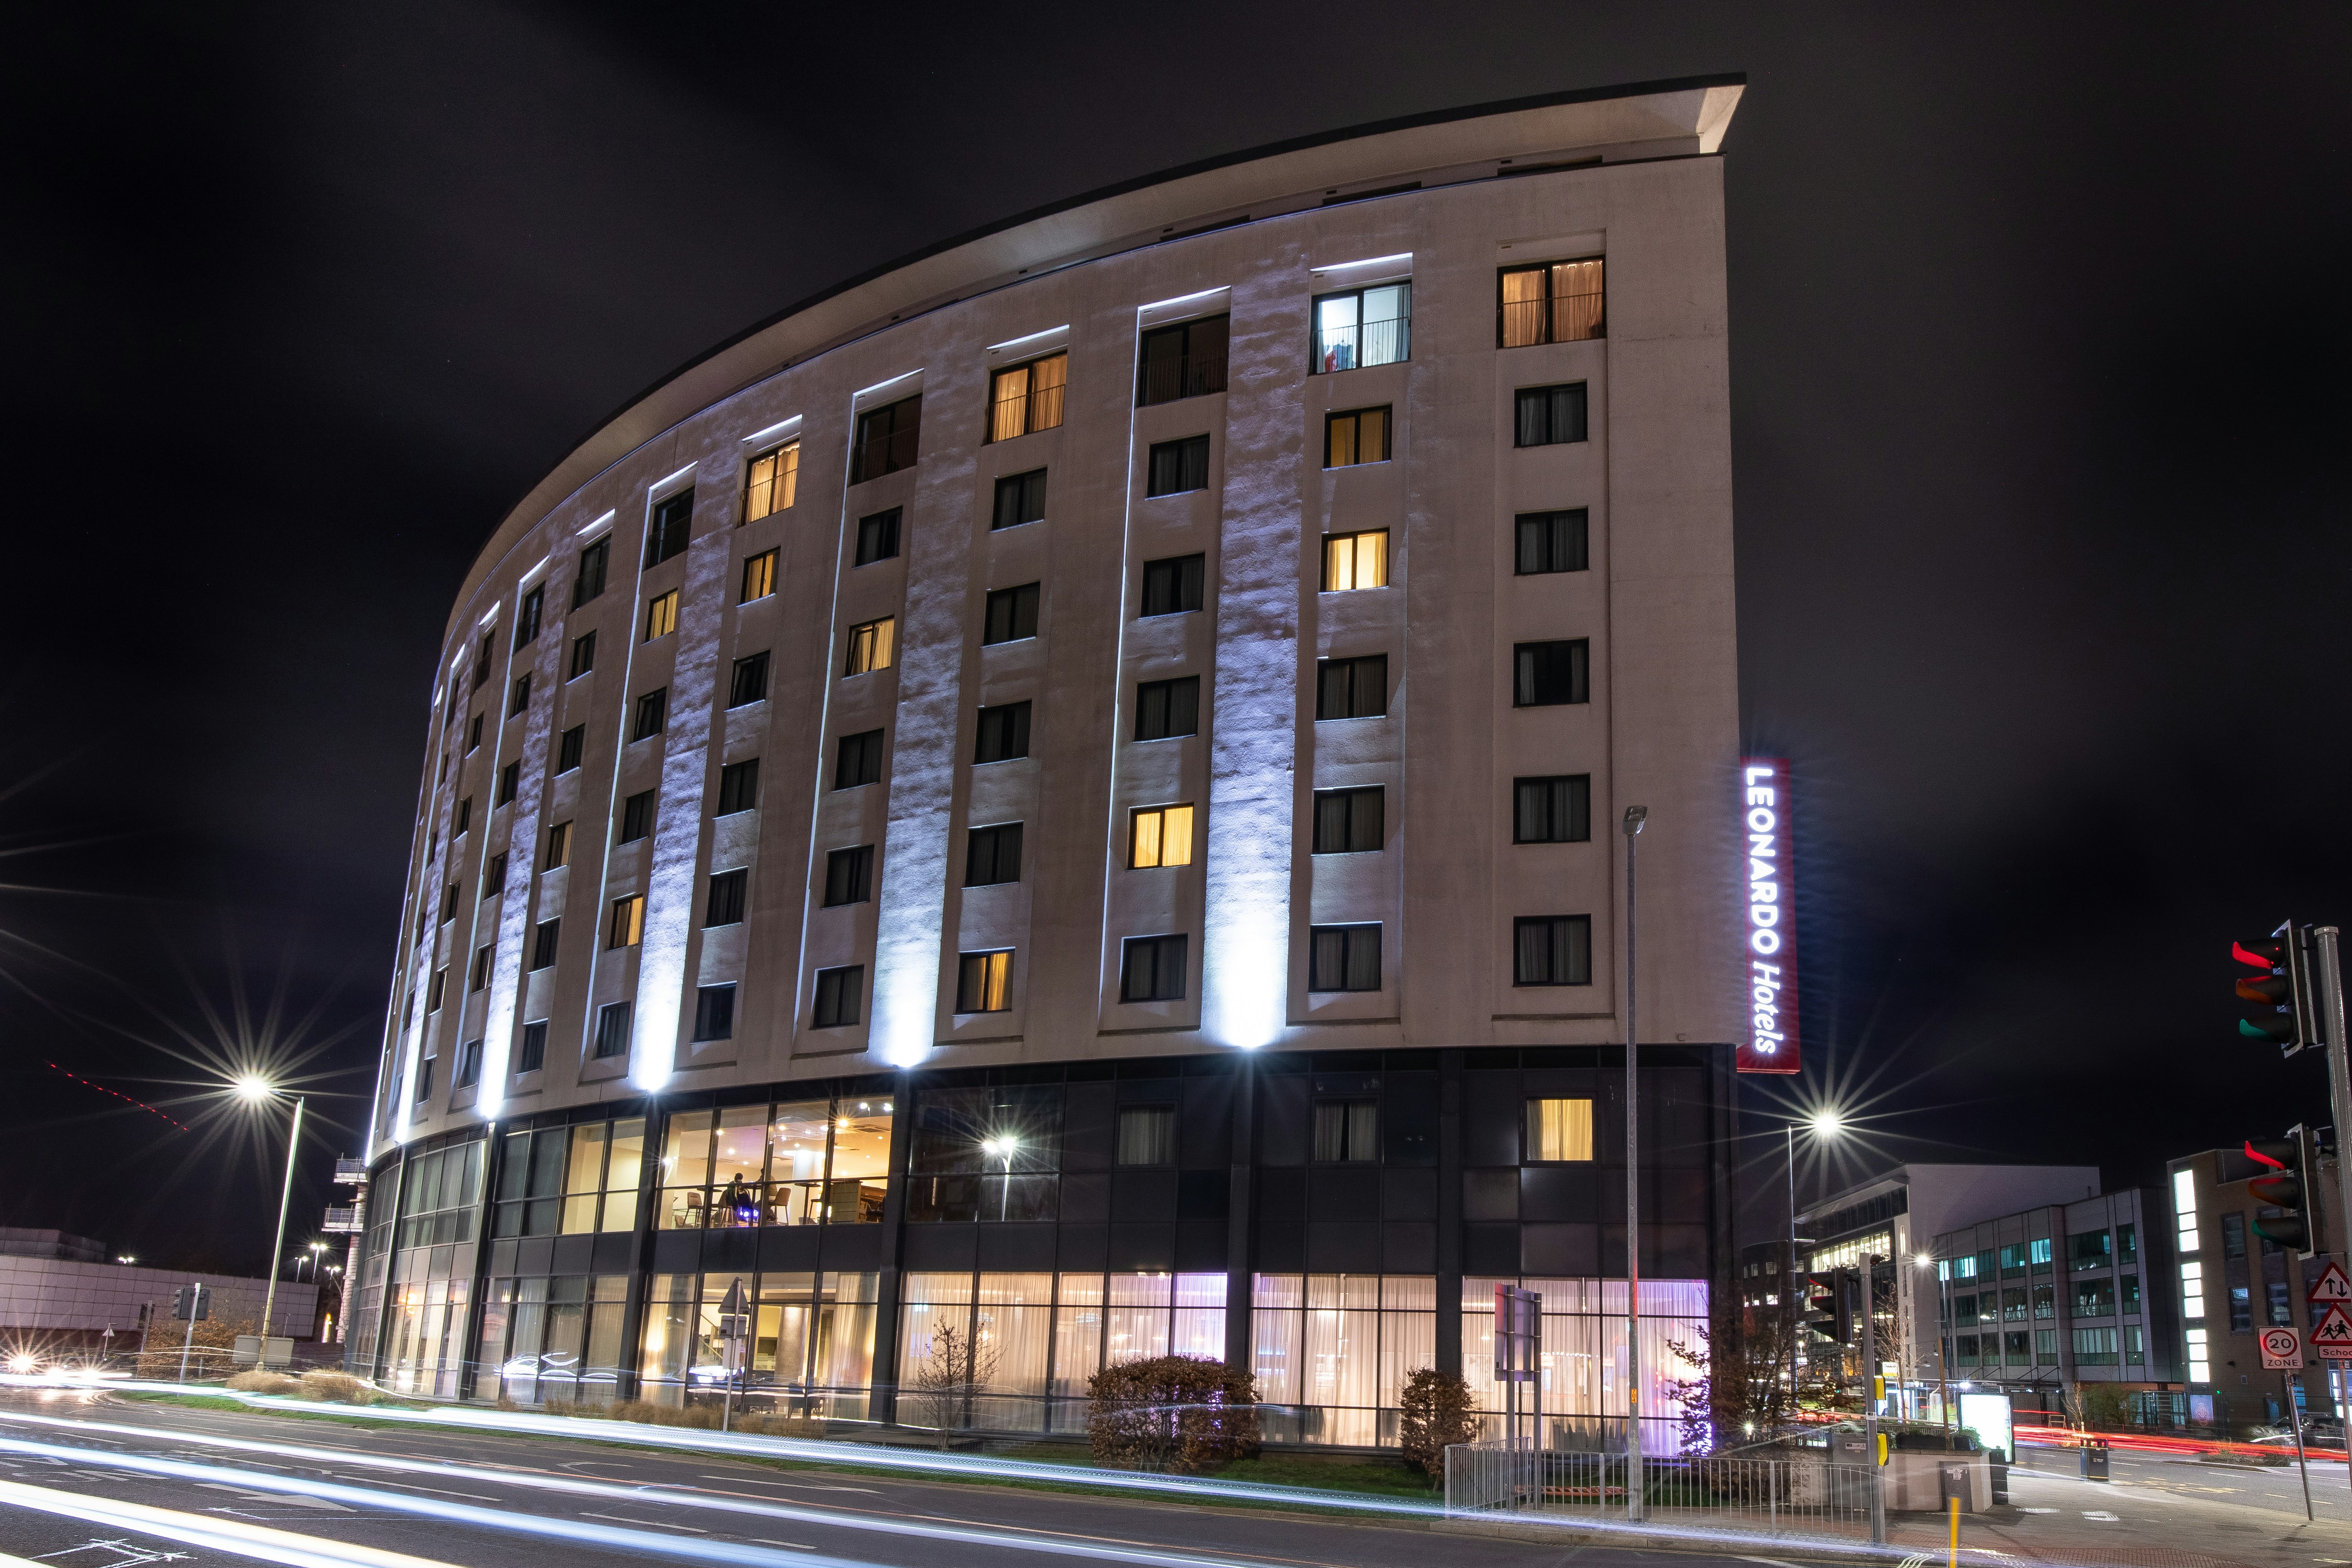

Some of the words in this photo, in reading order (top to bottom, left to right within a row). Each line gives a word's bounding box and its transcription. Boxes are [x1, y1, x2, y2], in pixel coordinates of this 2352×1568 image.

[1747, 767, 1779, 954] LEONARDO
[1753, 960, 1783, 1054] Hotels
[2269, 1338, 2291, 1349] 20
